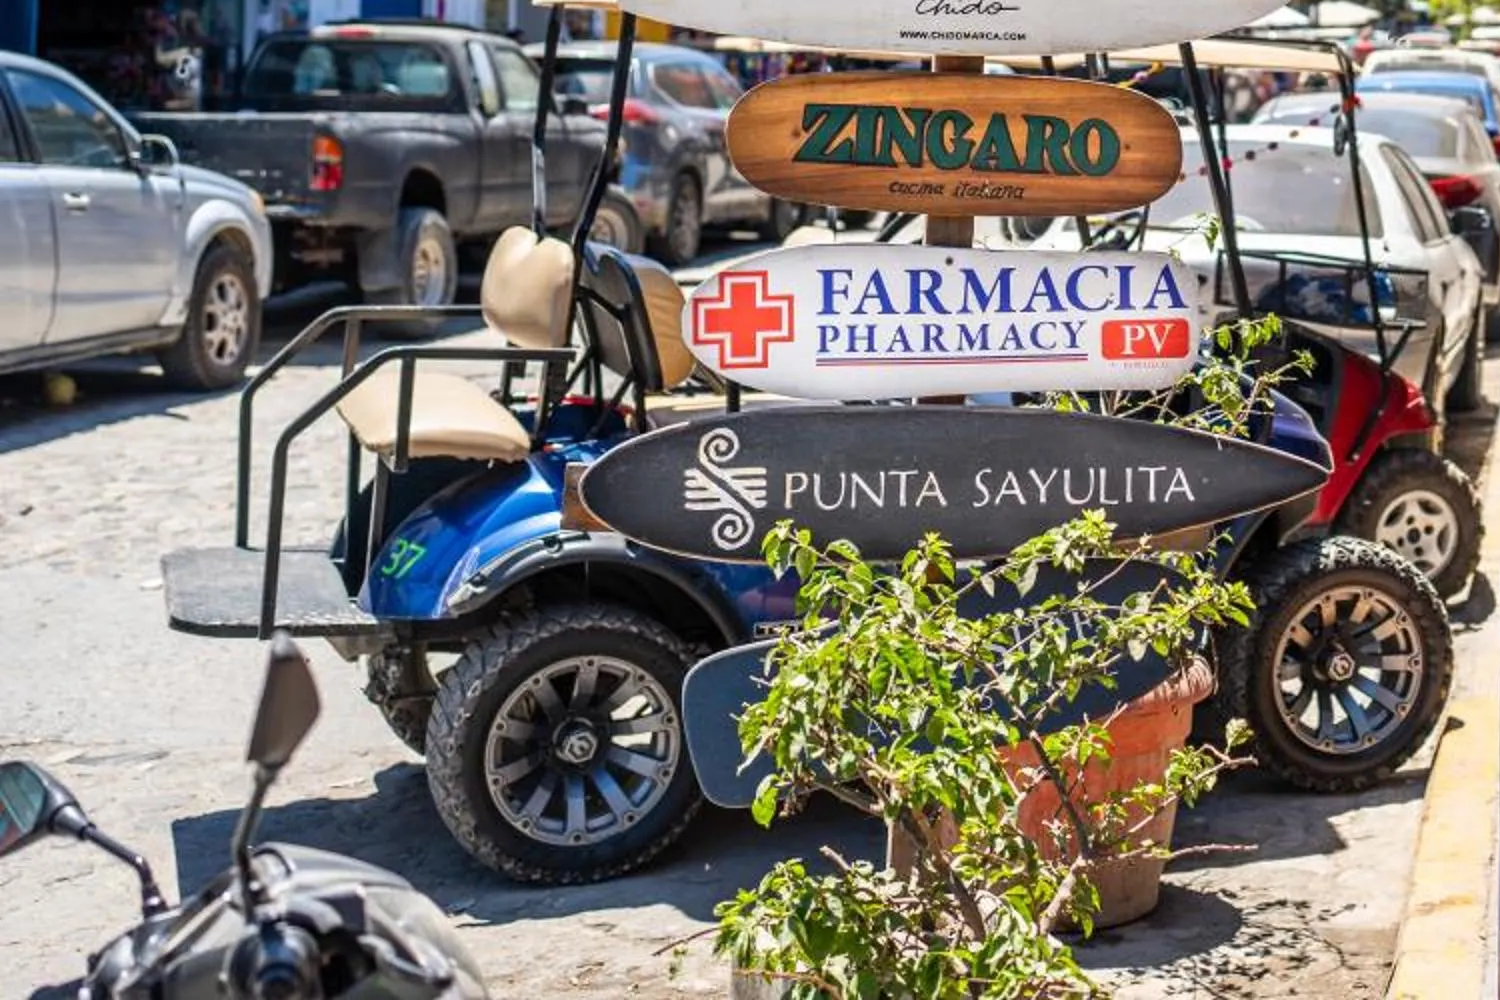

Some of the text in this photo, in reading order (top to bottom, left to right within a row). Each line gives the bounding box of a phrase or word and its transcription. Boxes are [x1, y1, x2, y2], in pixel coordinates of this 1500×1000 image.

[793, 103, 1121, 177] ZINGARO
[817, 263, 1189, 316] FARMACIA
[817, 320, 1087, 354] PHARMACY
[1120, 324, 1176, 356] PV
[784, 466, 1196, 510] PUNTA SAYULITA
[382, 538, 428, 580] 37
